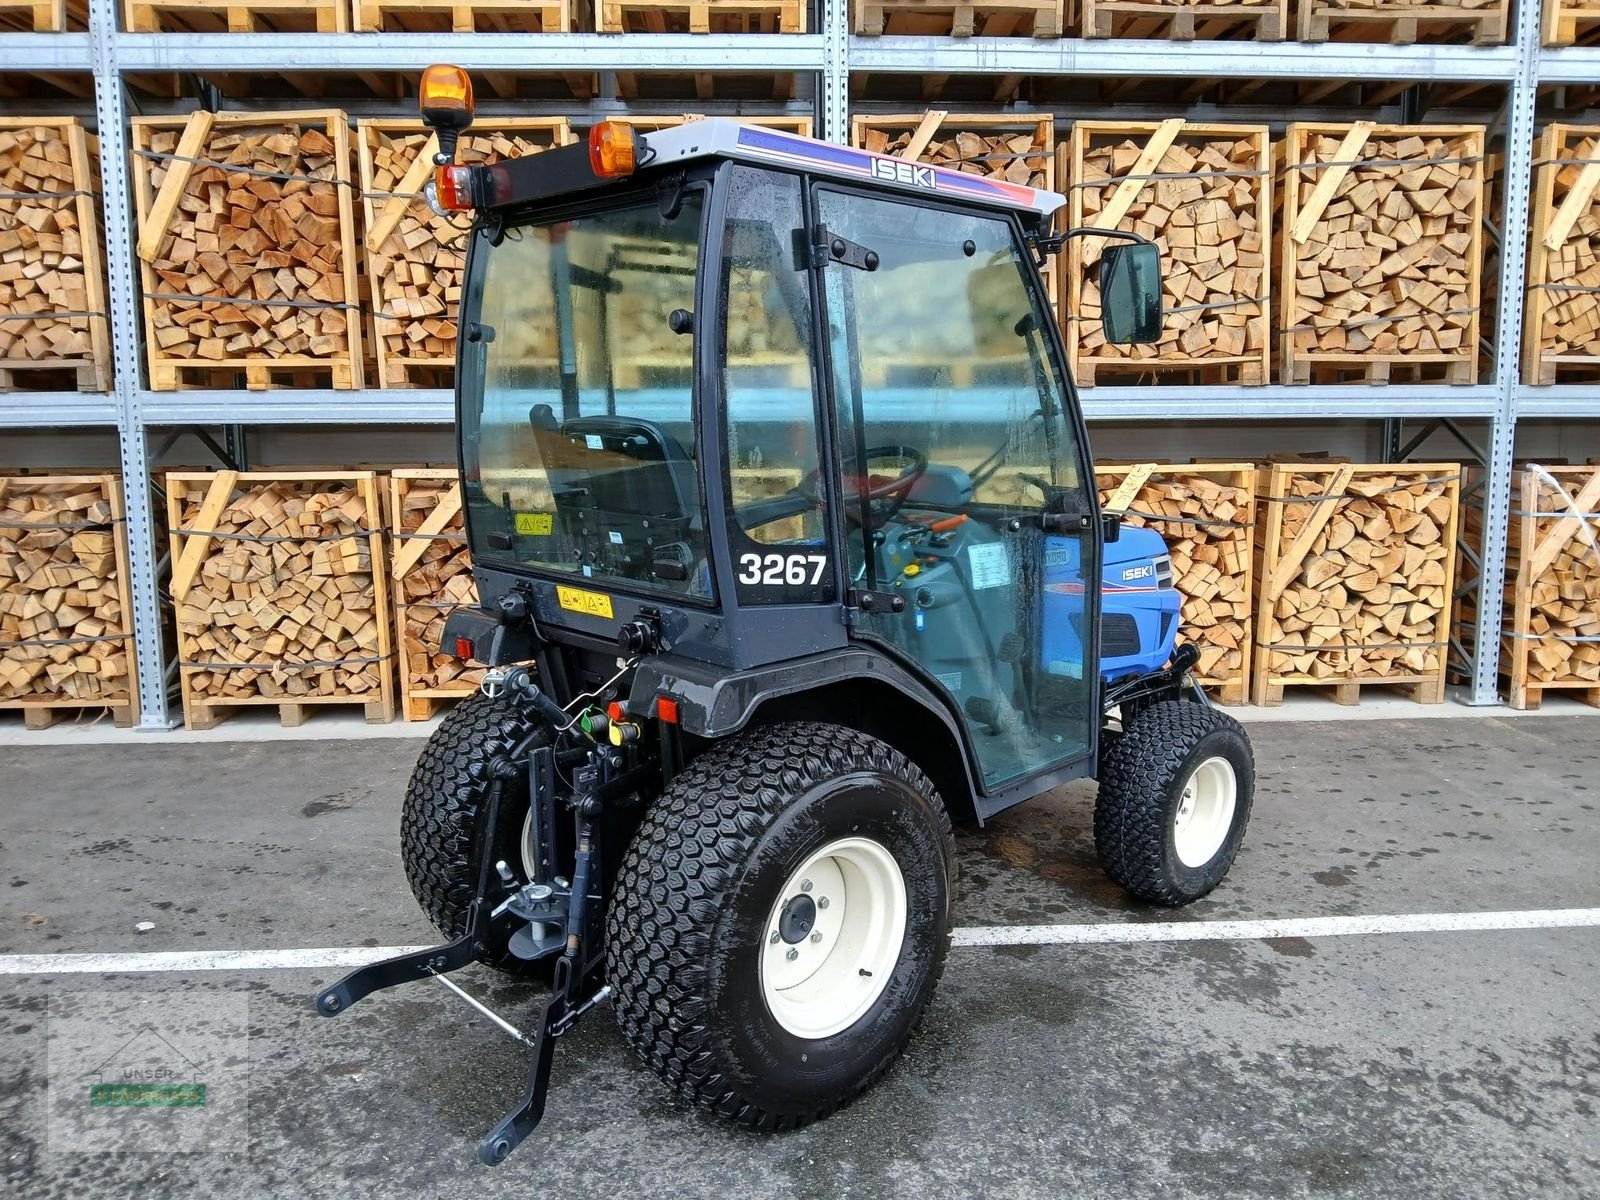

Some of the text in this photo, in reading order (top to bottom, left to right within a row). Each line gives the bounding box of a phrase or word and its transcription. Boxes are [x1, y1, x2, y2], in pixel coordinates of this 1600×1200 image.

[870, 156, 936, 189] ISEKI
[739, 553, 827, 585] 3267
[1122, 565, 1153, 581] ISEKI
